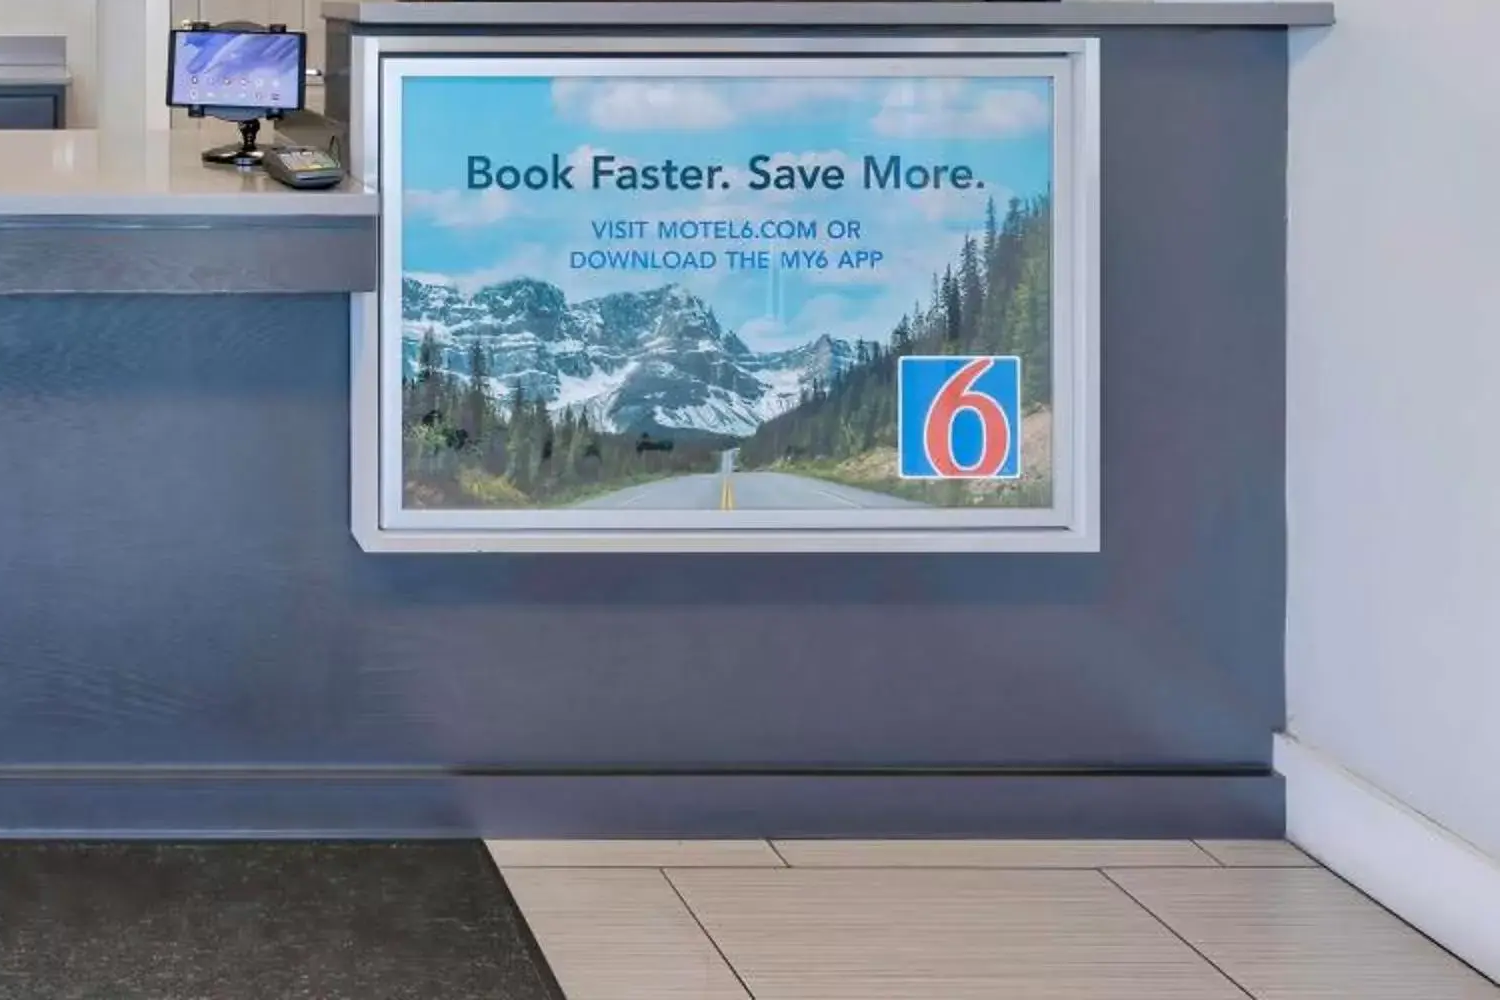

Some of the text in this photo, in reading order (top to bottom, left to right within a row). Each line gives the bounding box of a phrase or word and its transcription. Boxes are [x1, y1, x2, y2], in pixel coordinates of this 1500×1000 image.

[466, 153, 986, 192] Book Faster. Save More.
[591, 219, 861, 241] VISIT MOTEL6.COM OR
[570, 249, 884, 270] DOWNLOAD THE MY6 APP
[924, 356, 1010, 478] 6
